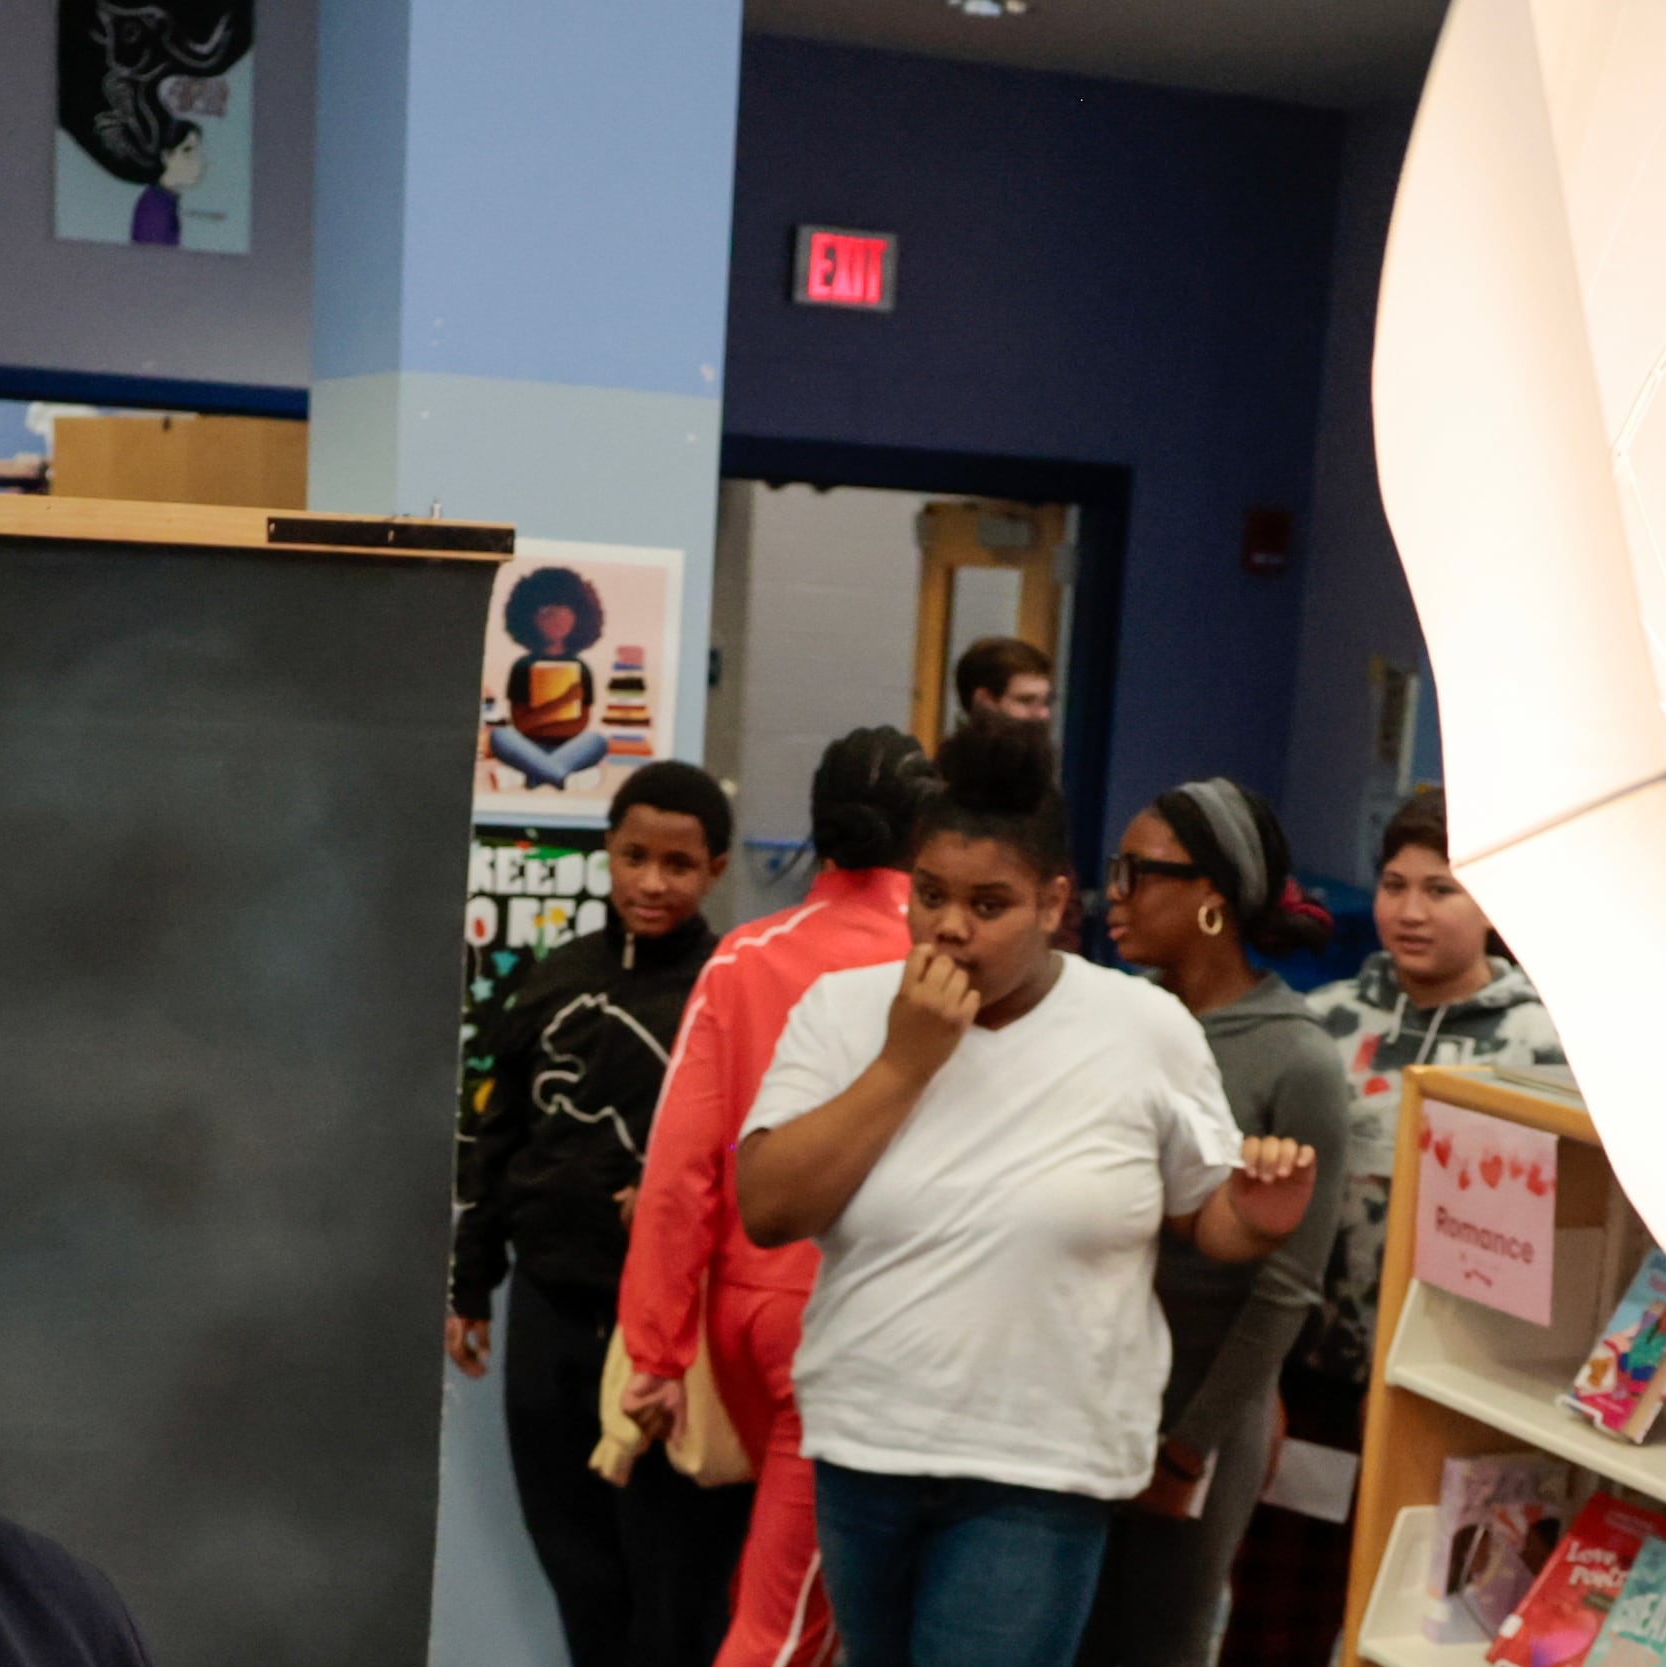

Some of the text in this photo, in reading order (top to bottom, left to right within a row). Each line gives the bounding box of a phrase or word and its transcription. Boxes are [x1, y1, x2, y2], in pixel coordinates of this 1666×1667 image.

[807, 232, 888, 304] EXIT
[467, 844, 613, 896] REEDO
[1435, 1205, 1534, 1265] Romance
